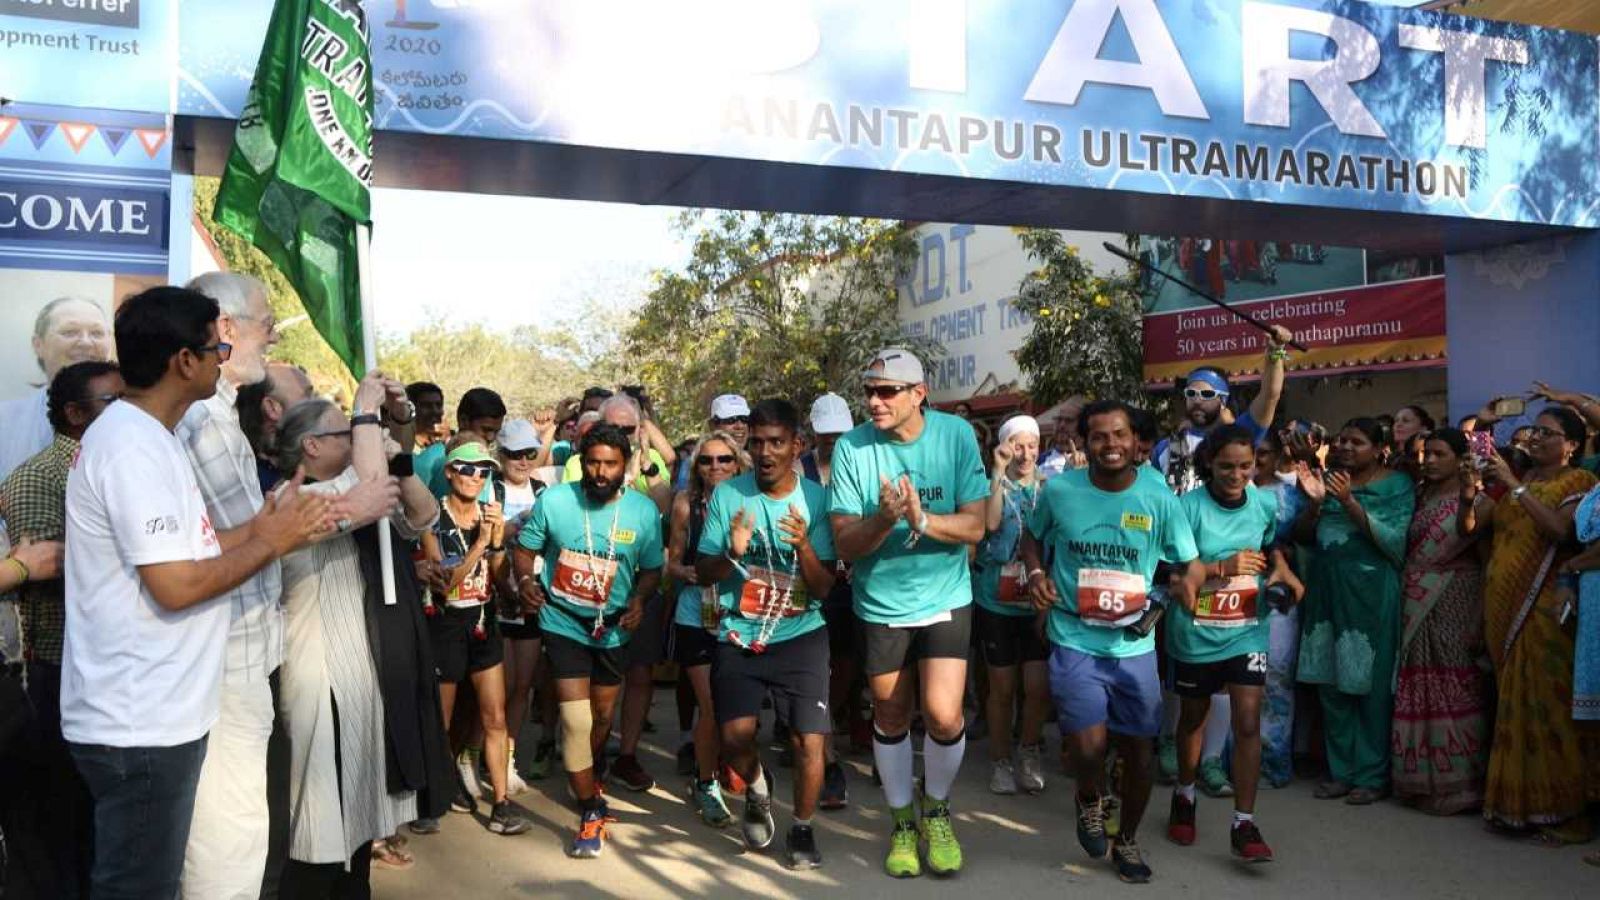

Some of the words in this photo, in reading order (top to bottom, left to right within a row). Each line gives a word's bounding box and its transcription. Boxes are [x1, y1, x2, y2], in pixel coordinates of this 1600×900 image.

[86, 35, 140, 55] Trust
[384, 34, 441, 55] 2020
[719, 94, 1062, 163] ANANTAPUR
[1083, 129, 1467, 198] ULTRAMARATHON
[1176, 313, 1206, 334] Join
[1211, 313, 1227, 326] us
[1251, 297, 1346, 321] celebrating
[1177, 339, 1195, 355] 50
[1199, 337, 1237, 357] years
[1242, 331, 1257, 349] in
[1098, 590, 1126, 613] 65
[1215, 592, 1240, 611] 70
